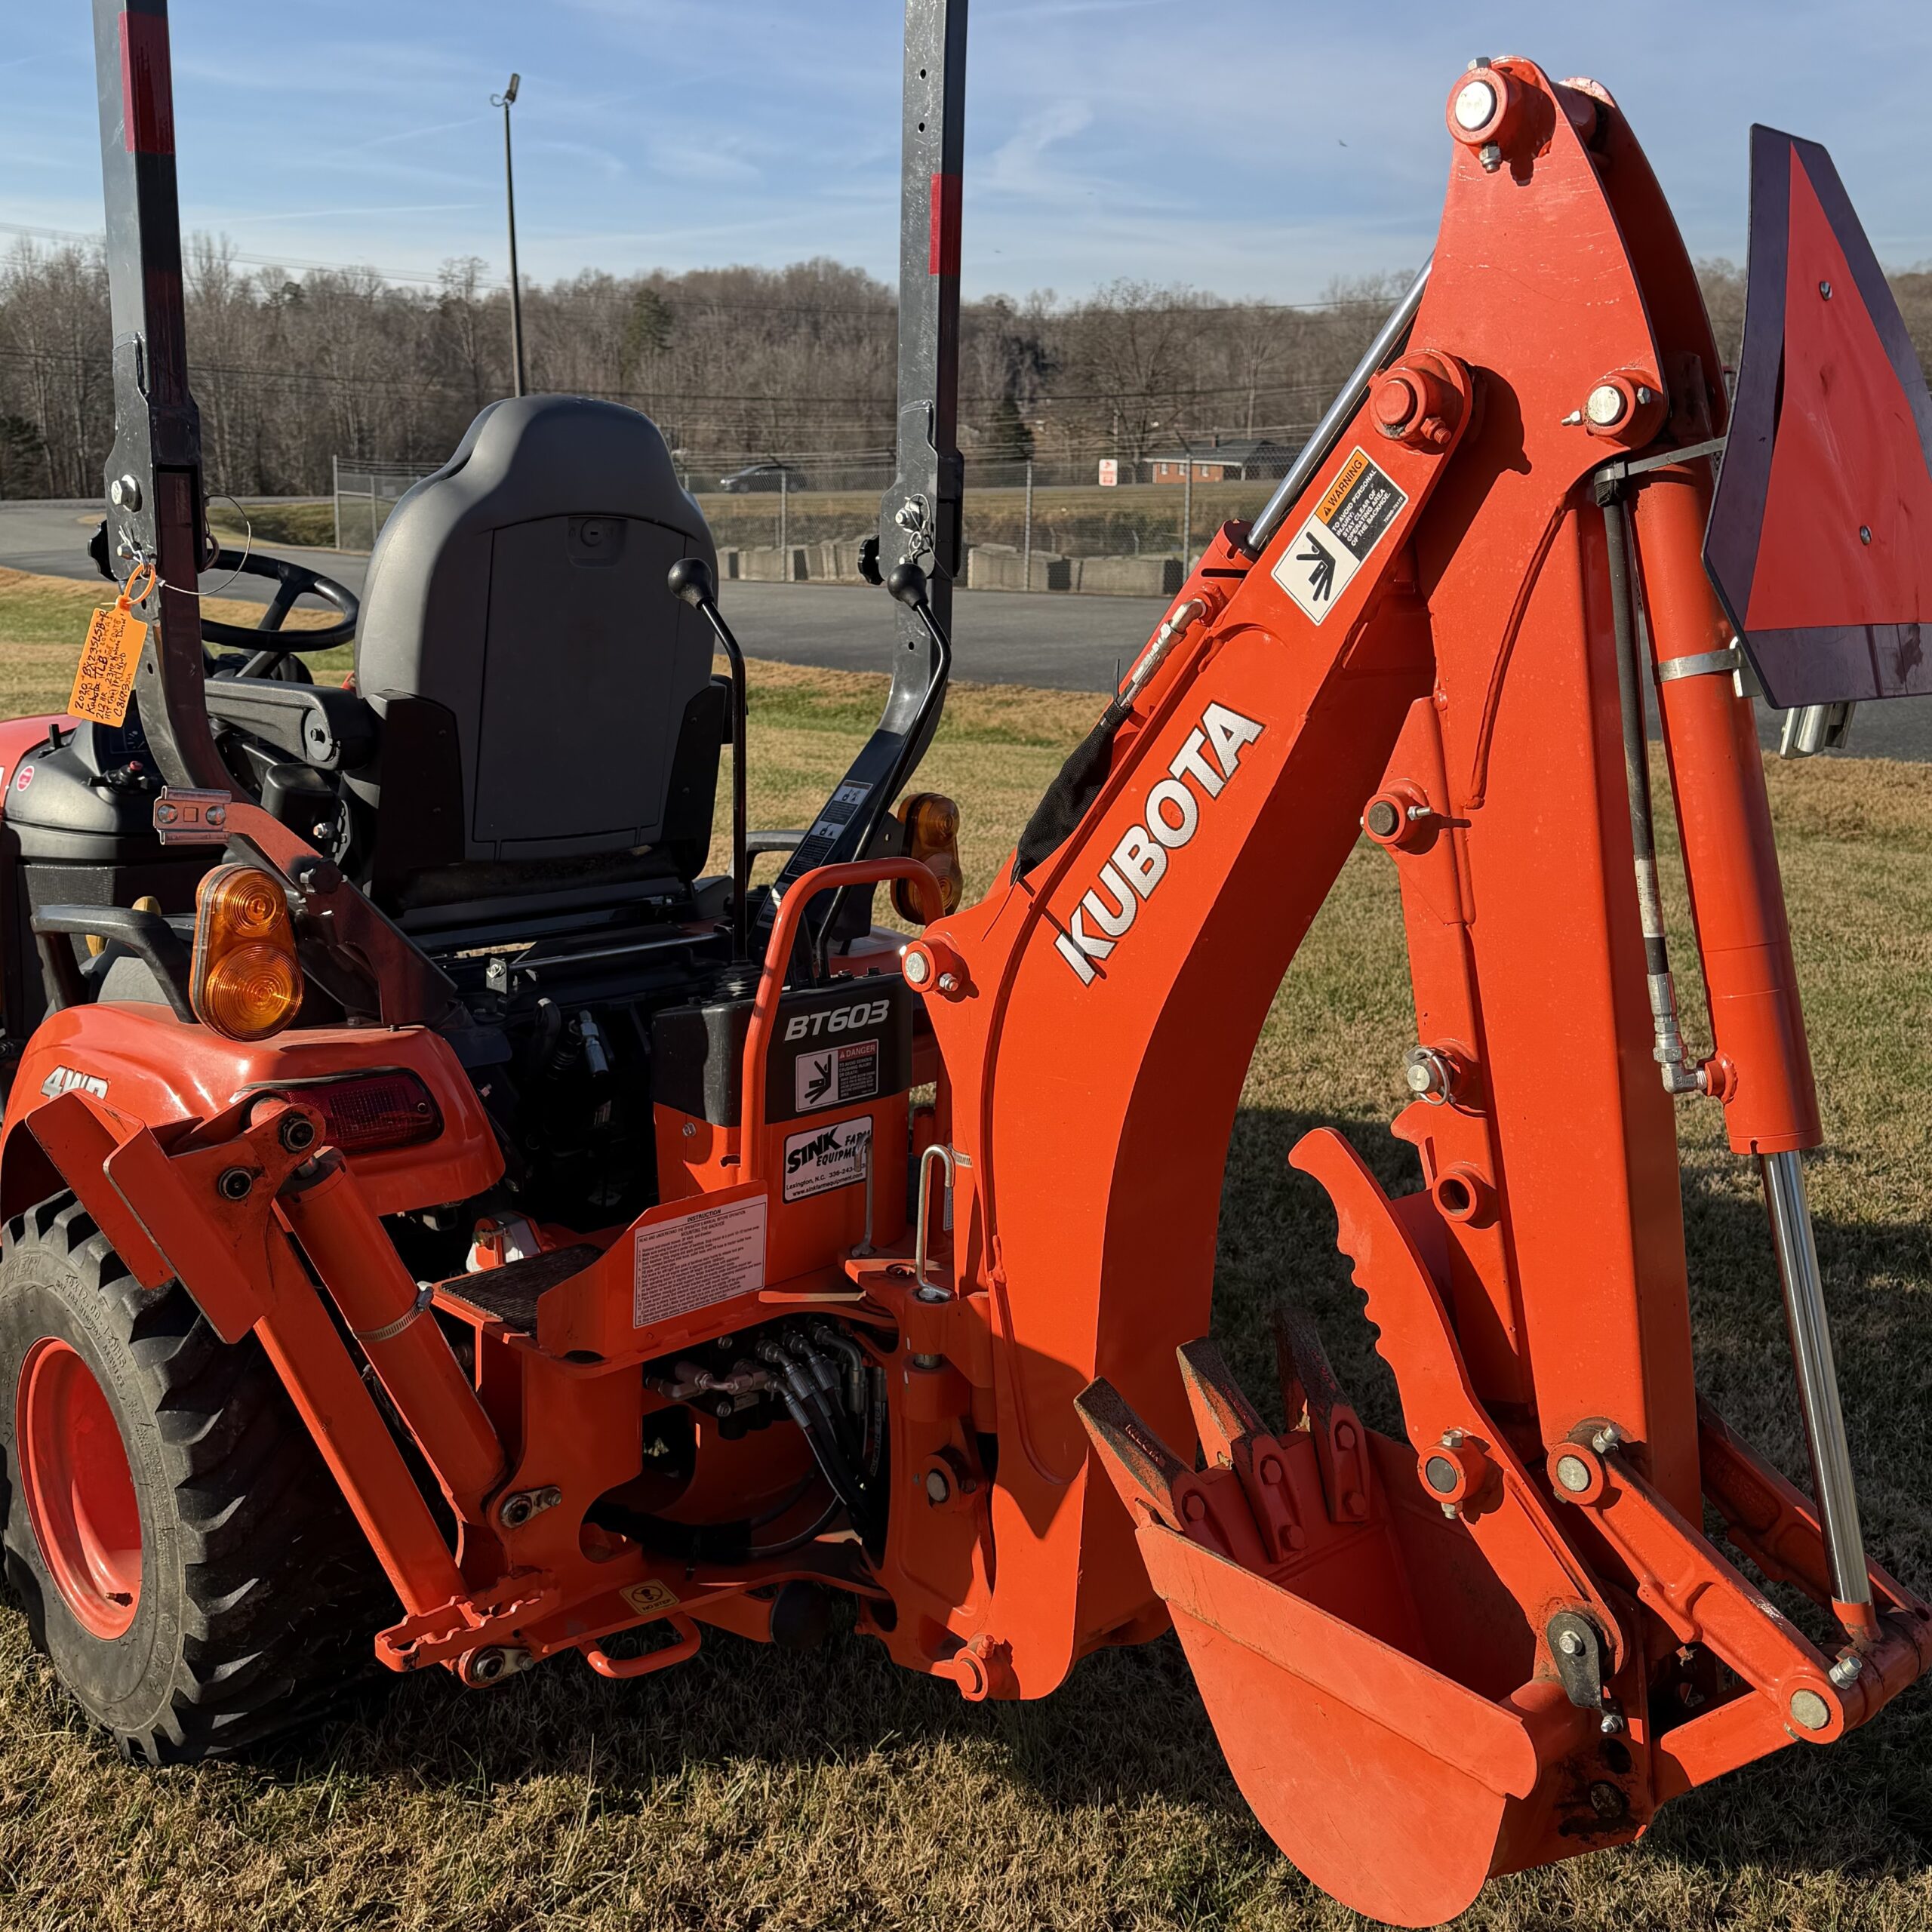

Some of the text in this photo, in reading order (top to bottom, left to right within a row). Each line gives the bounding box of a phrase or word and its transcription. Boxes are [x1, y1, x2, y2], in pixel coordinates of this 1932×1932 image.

[1328, 460, 1362, 504] WARNING
[1331, 468, 1377, 531] TO AVOID PERSONAL
[1342, 489, 1377, 537] STAY CLEAR OF
[1346, 488, 1385, 542] OPERATING AREA
[1335, 511, 1355, 536] INJURY:
[1349, 491, 1391, 546] OF THE BACKHOE.
[92, 654, 109, 680] TLB
[73, 682, 89, 709] 2020
[1054, 700, 1266, 986] KUBOTA
[784, 998, 891, 1042] BT603
[845, 1044, 875, 1058] DANGER
[40, 1067, 109, 1100] 4WD
[787, 1126, 842, 1174] SINK
[817, 1143, 867, 1167] EQUIPME
[786, 1177, 814, 1190] Lexington,
[792, 1172, 863, 1196] www.sinkfarmequipment.com
[687, 1208, 721, 1222] INSTRUCTION
